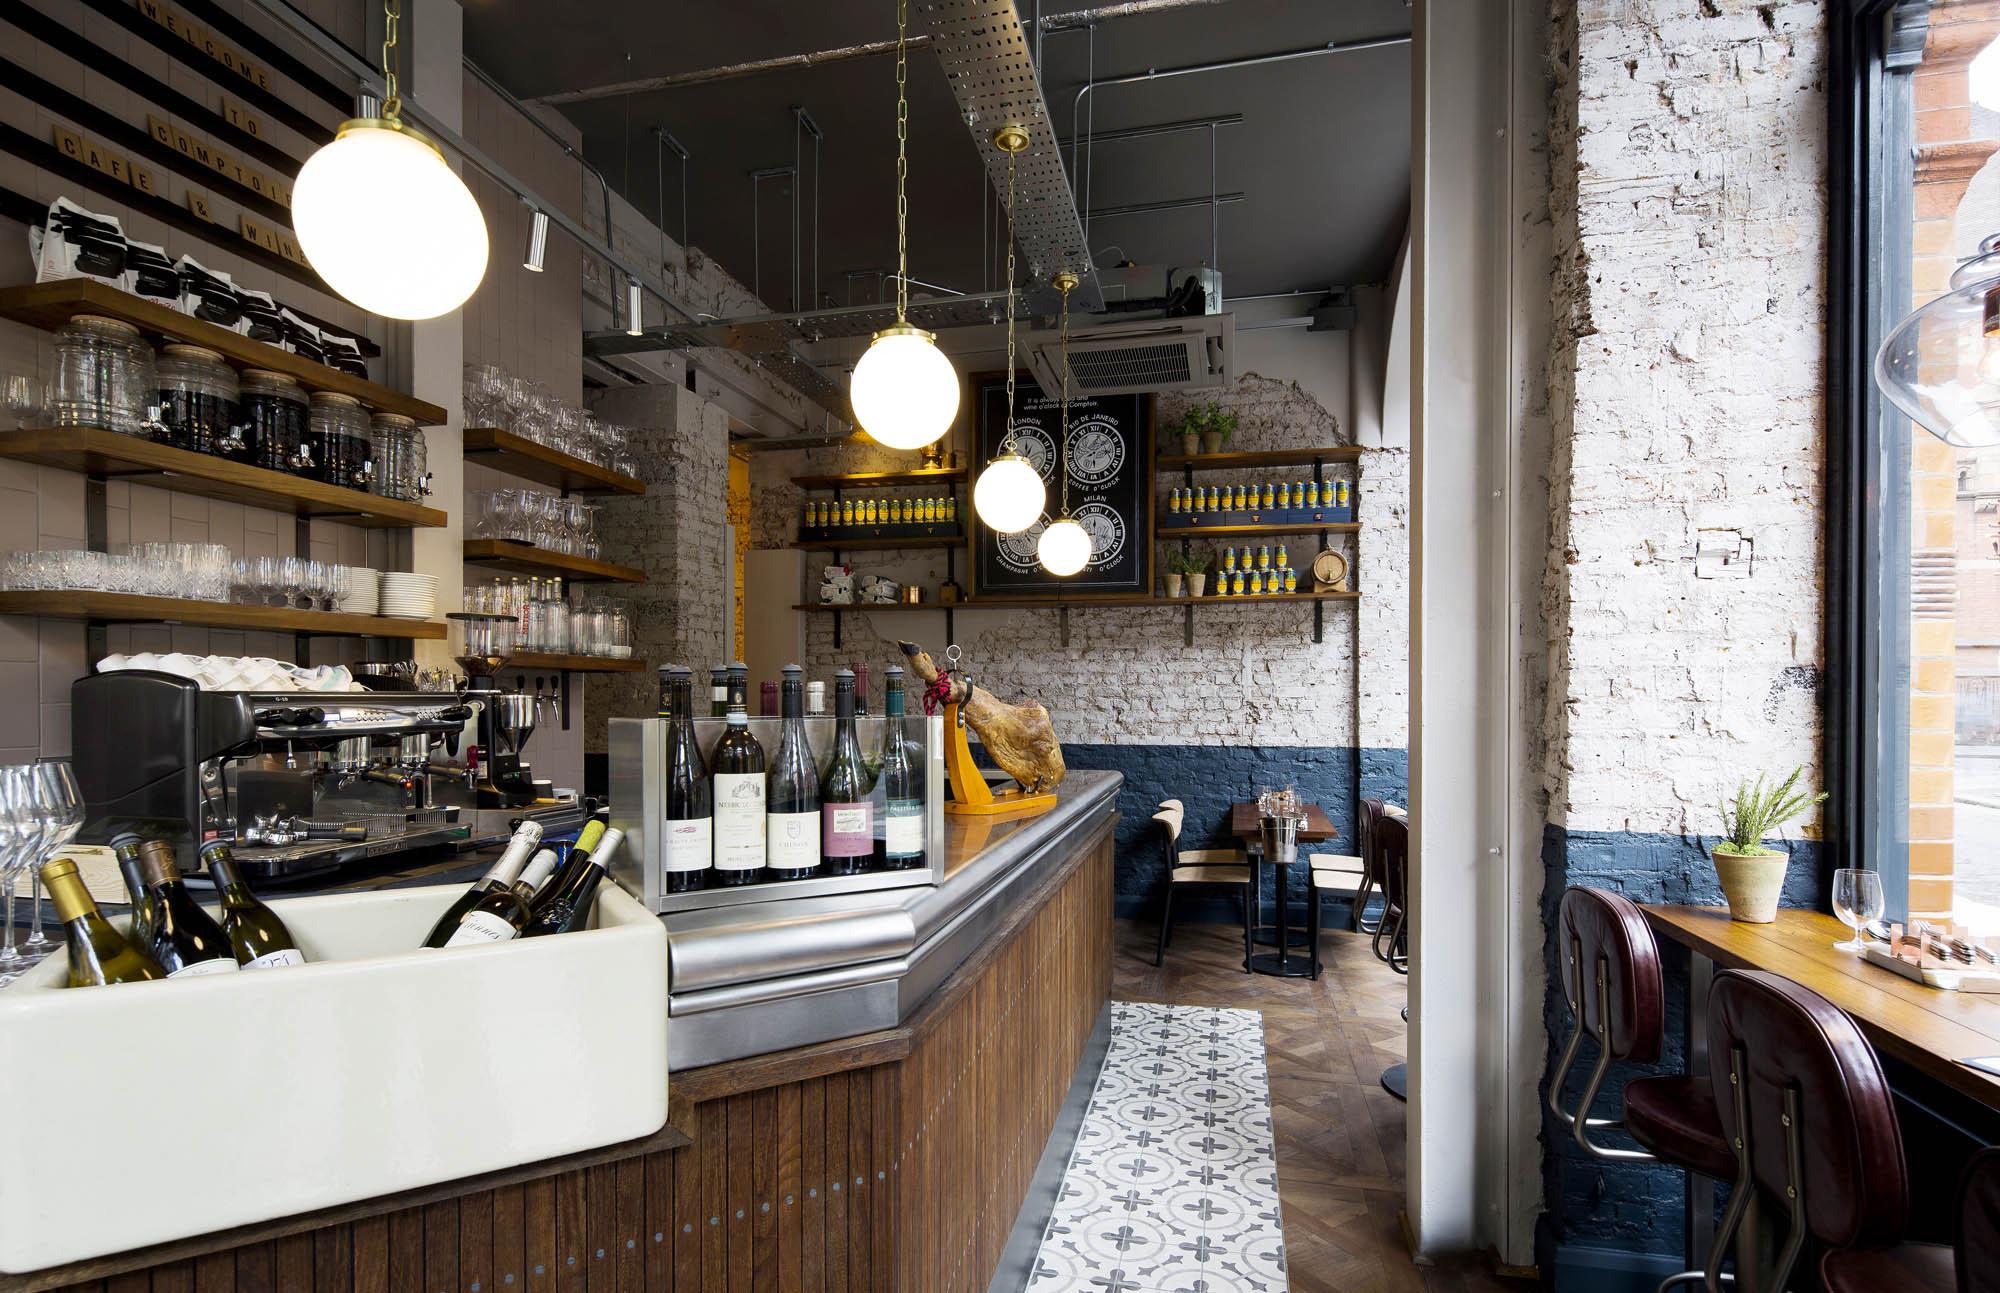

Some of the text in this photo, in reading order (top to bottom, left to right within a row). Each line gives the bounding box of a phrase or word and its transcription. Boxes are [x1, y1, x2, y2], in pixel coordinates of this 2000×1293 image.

[144, 2, 267, 88] WELCOME
[232, 109, 257, 134] TO
[64, 138, 149, 190] CAFE
[197, 201, 208, 216] &
[1013, 418, 1042, 426] LONDON
[1068, 421, 1080, 430] RIO
[1092, 414, 1119, 426] JANEIRO
[1068, 479, 1089, 491] COFFEE
[1094, 476, 1120, 492] O'CLOCK
[996, 555, 1028, 574] CHAMPAGNE
[1100, 554, 1124, 572] O'CLOCK
